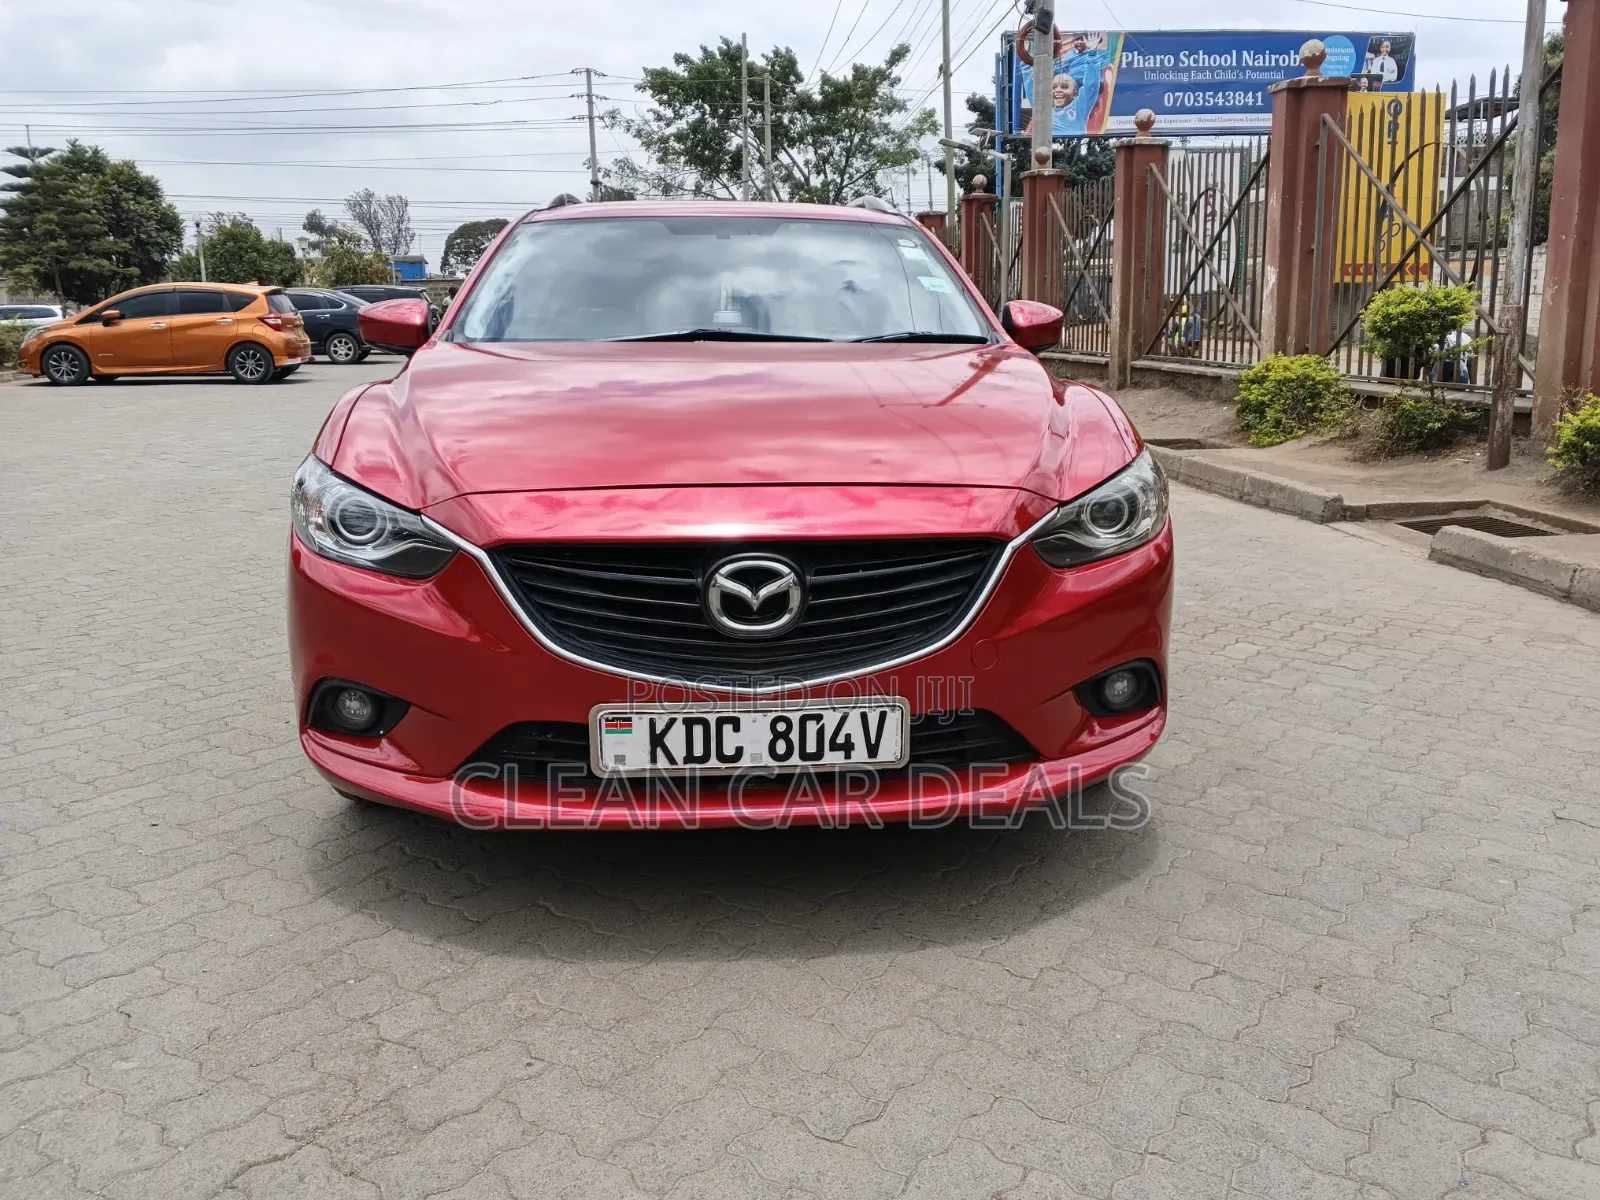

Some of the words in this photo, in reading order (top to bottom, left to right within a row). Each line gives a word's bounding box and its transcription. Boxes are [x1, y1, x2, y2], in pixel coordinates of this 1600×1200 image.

[1121, 51, 1175, 68] Pharo
[1179, 50, 1237, 67] School
[1241, 50, 1304, 67] Nairob
[1144, 69, 1189, 81] Unlocking
[1191, 69, 1211, 80] Each
[1214, 69, 1244, 79] Child's
[1245, 69, 1284, 79] Potential
[1164, 91, 1264, 107] 0703543841
[649, 716, 744, 765] KDC
[768, 710, 888, 762] 804V
